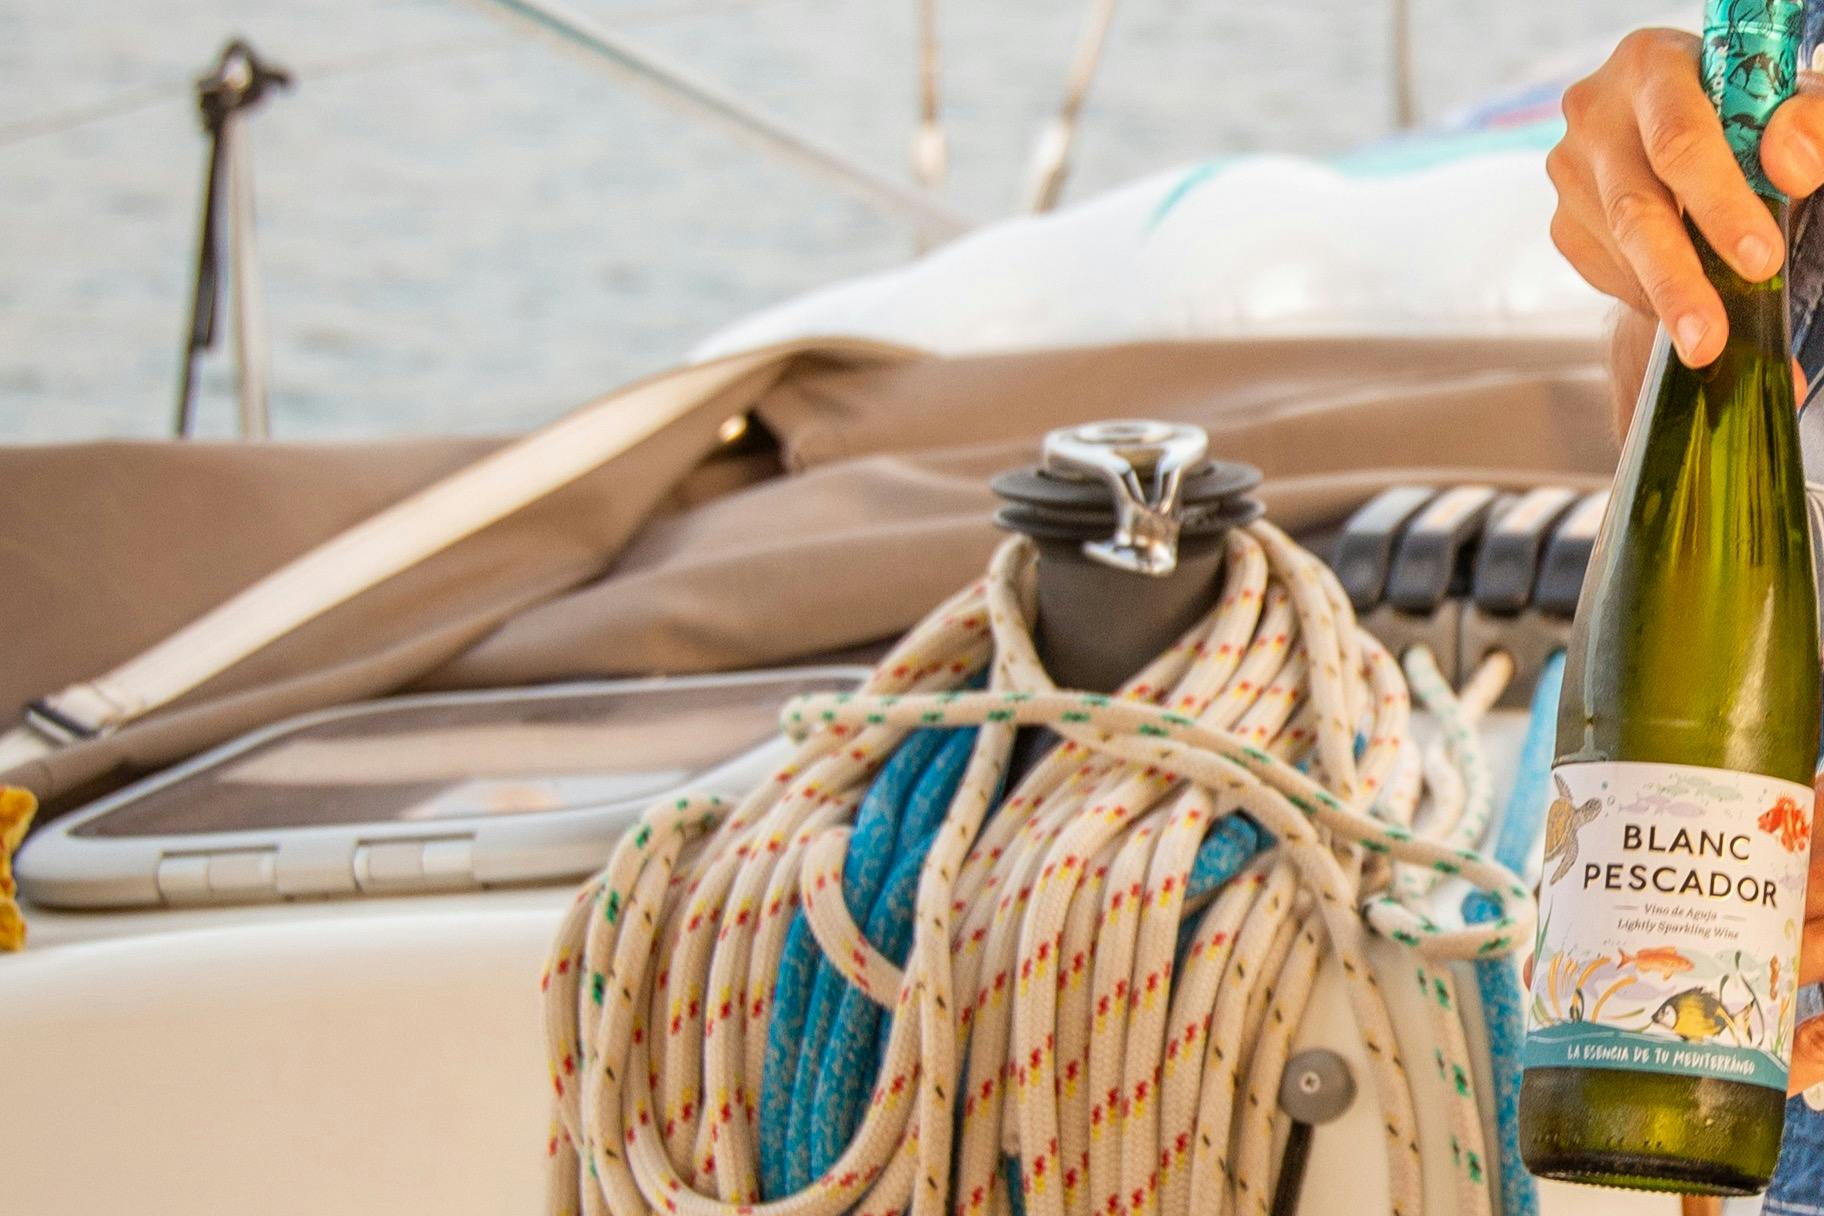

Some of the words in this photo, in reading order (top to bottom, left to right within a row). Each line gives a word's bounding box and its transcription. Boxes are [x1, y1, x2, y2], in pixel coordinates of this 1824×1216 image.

[1622, 822, 1751, 862] BLANC
[1582, 862, 1778, 910] PESCADOR
[1644, 902, 1670, 916] Vino
[1671, 904, 1685, 917] de
[1686, 907, 1718, 922] Aguja
[1617, 918, 1657, 934] Lightly
[1658, 921, 1711, 939] Sparkling
[1713, 927, 1740, 940] Wine
[1567, 1043, 1580, 1061] LA
[1583, 1045, 1629, 1063] ESENCIA
[1633, 1045, 1650, 1064] DE
[1655, 1047, 1669, 1065] TU
